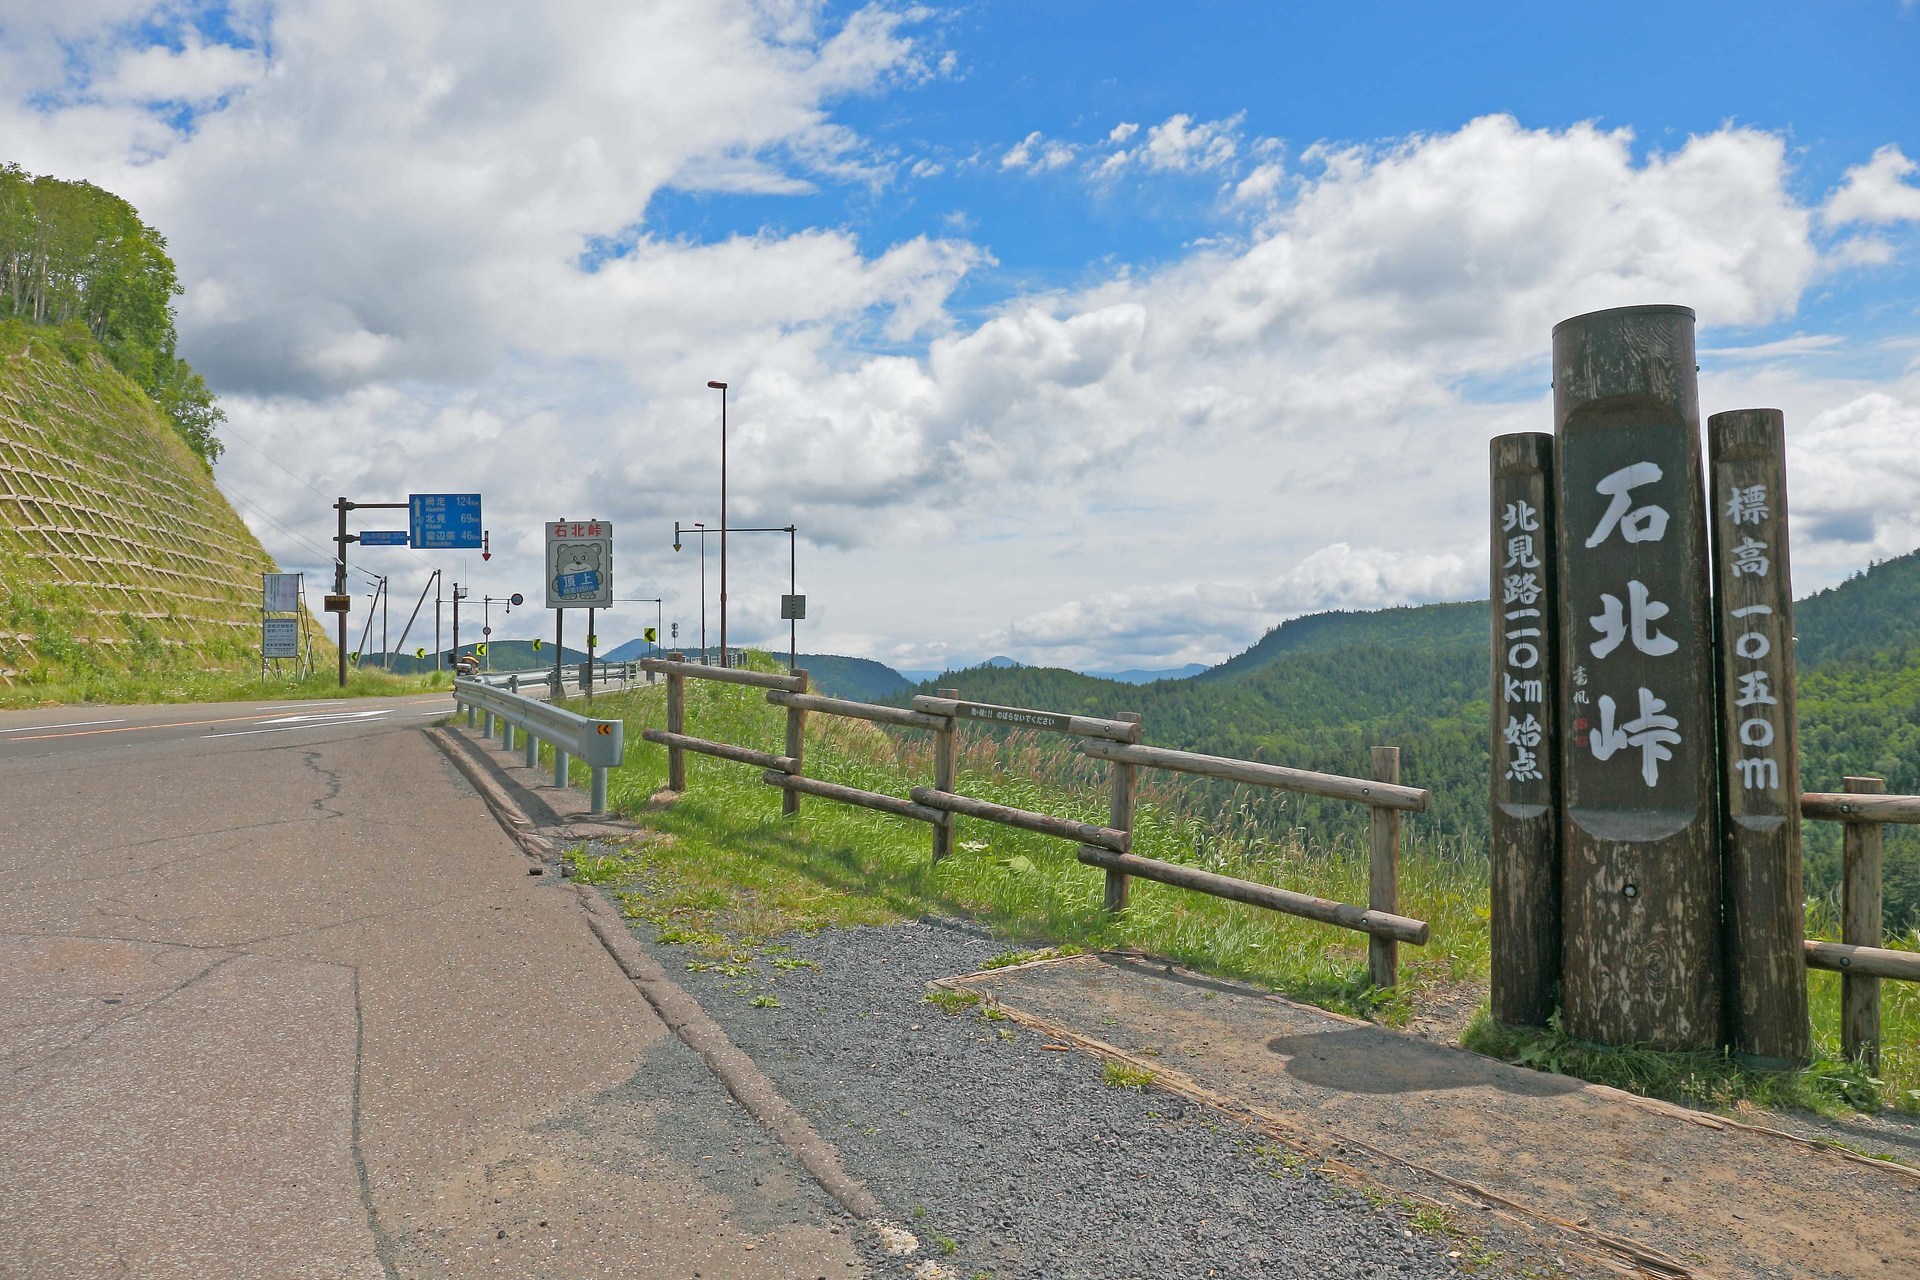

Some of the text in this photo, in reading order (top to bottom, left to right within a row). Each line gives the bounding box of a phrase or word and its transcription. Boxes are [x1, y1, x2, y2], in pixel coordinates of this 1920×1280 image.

[425, 497, 446, 506] 網走
[425, 514, 446, 523] 北見
[554, 523, 602, 538] 石北峠
[563, 573, 592, 588] 頂上
[1584, 461, 1682, 788] 石北峠
[996, 711, 1054, 725] のぼらないでください
